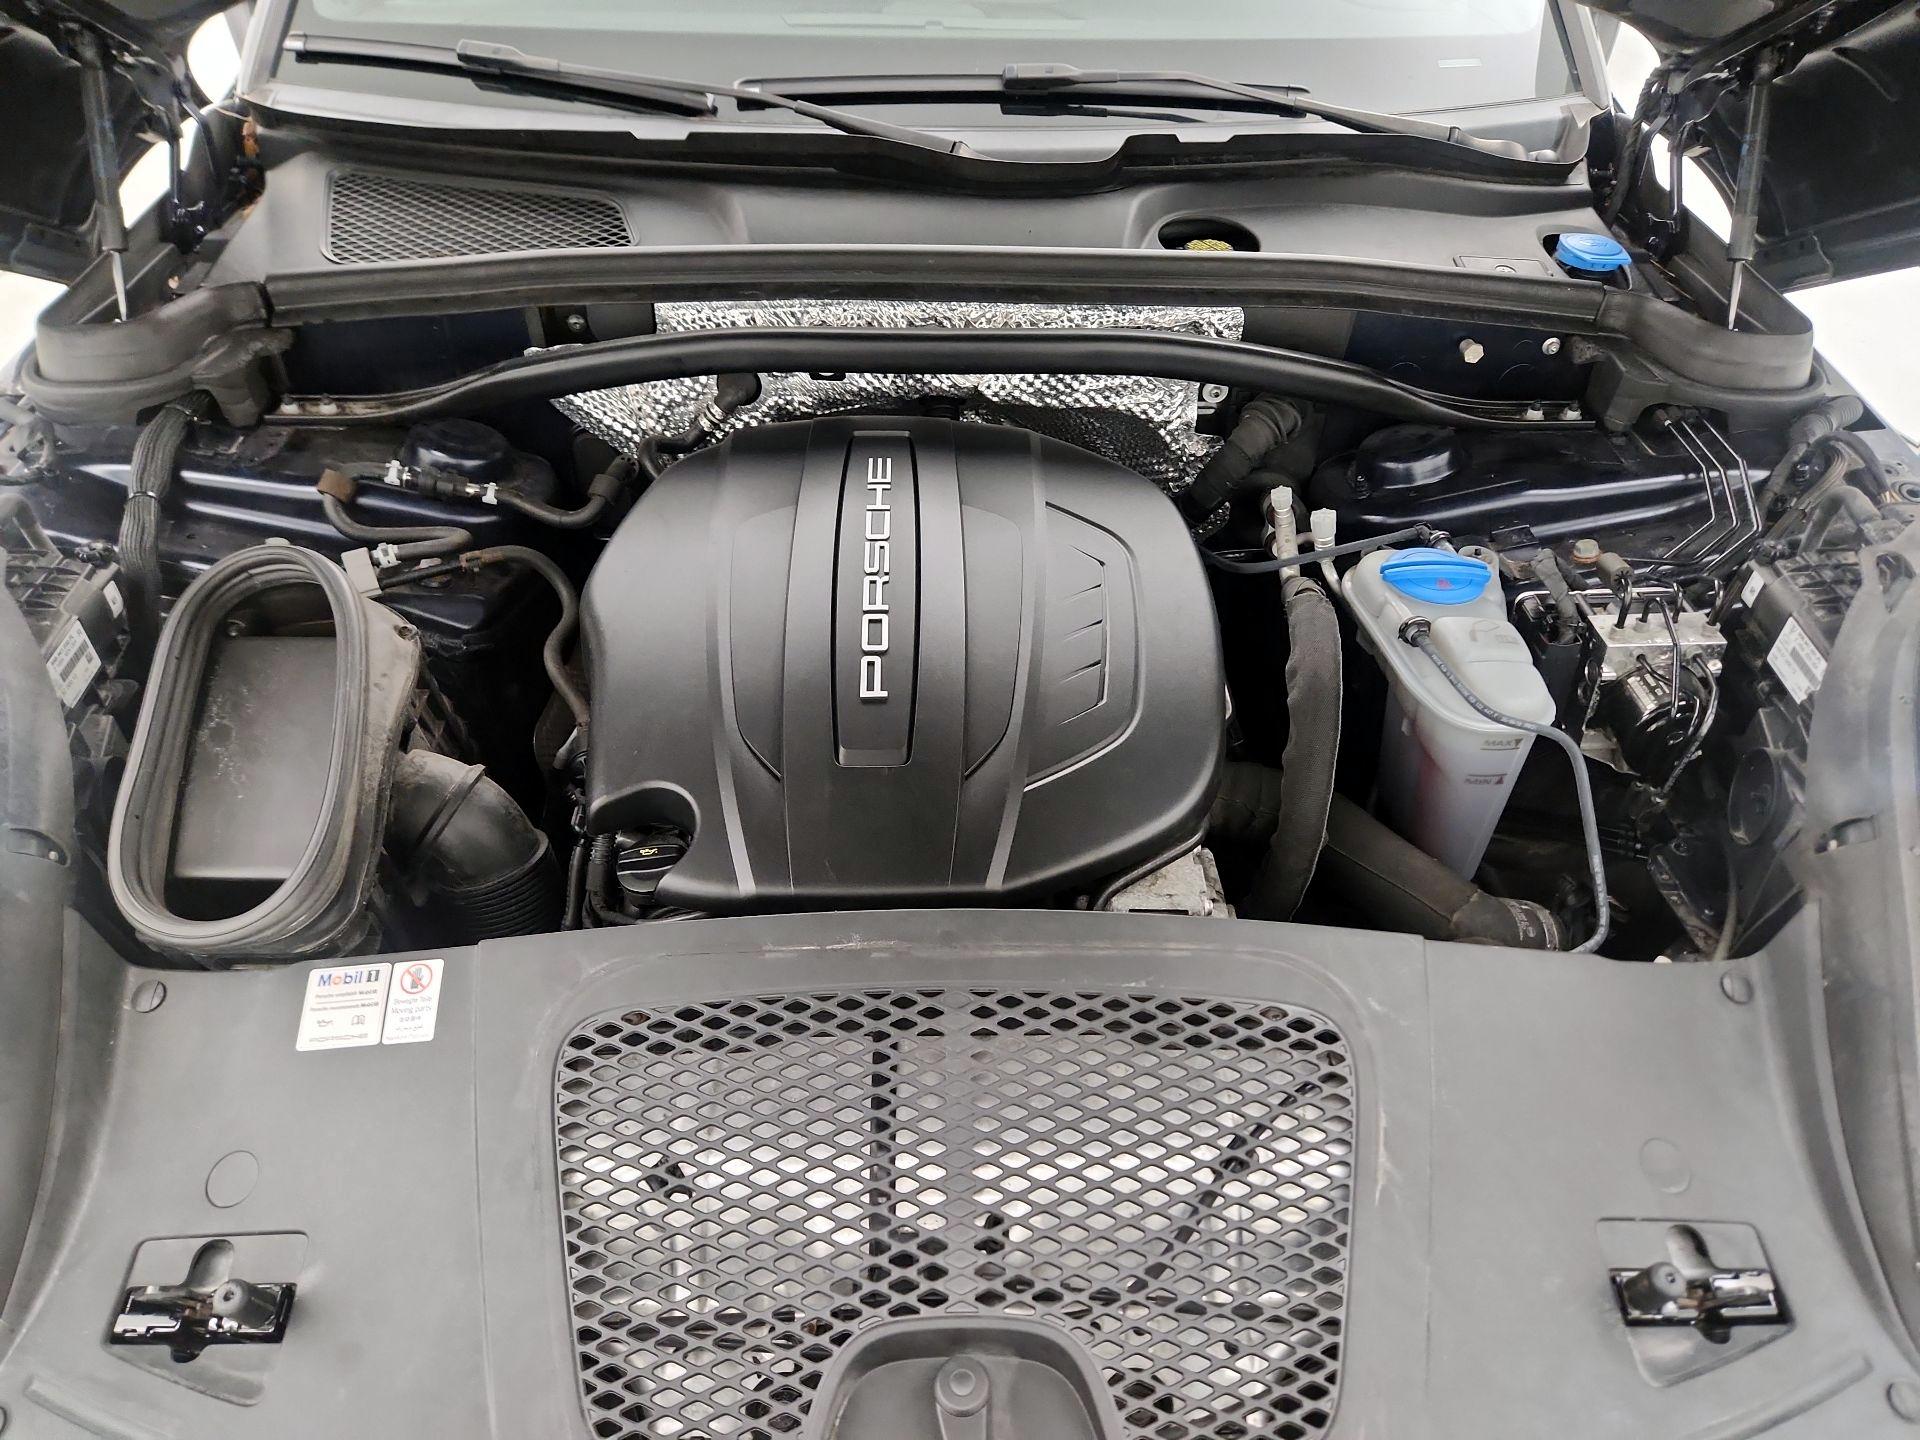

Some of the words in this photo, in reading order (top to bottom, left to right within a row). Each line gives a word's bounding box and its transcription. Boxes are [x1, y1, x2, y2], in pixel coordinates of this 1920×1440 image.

[859, 457, 892, 698] PORSCHE
[1483, 739, 1512, 747] MAX
[317, 971, 363, 987] Mobil
